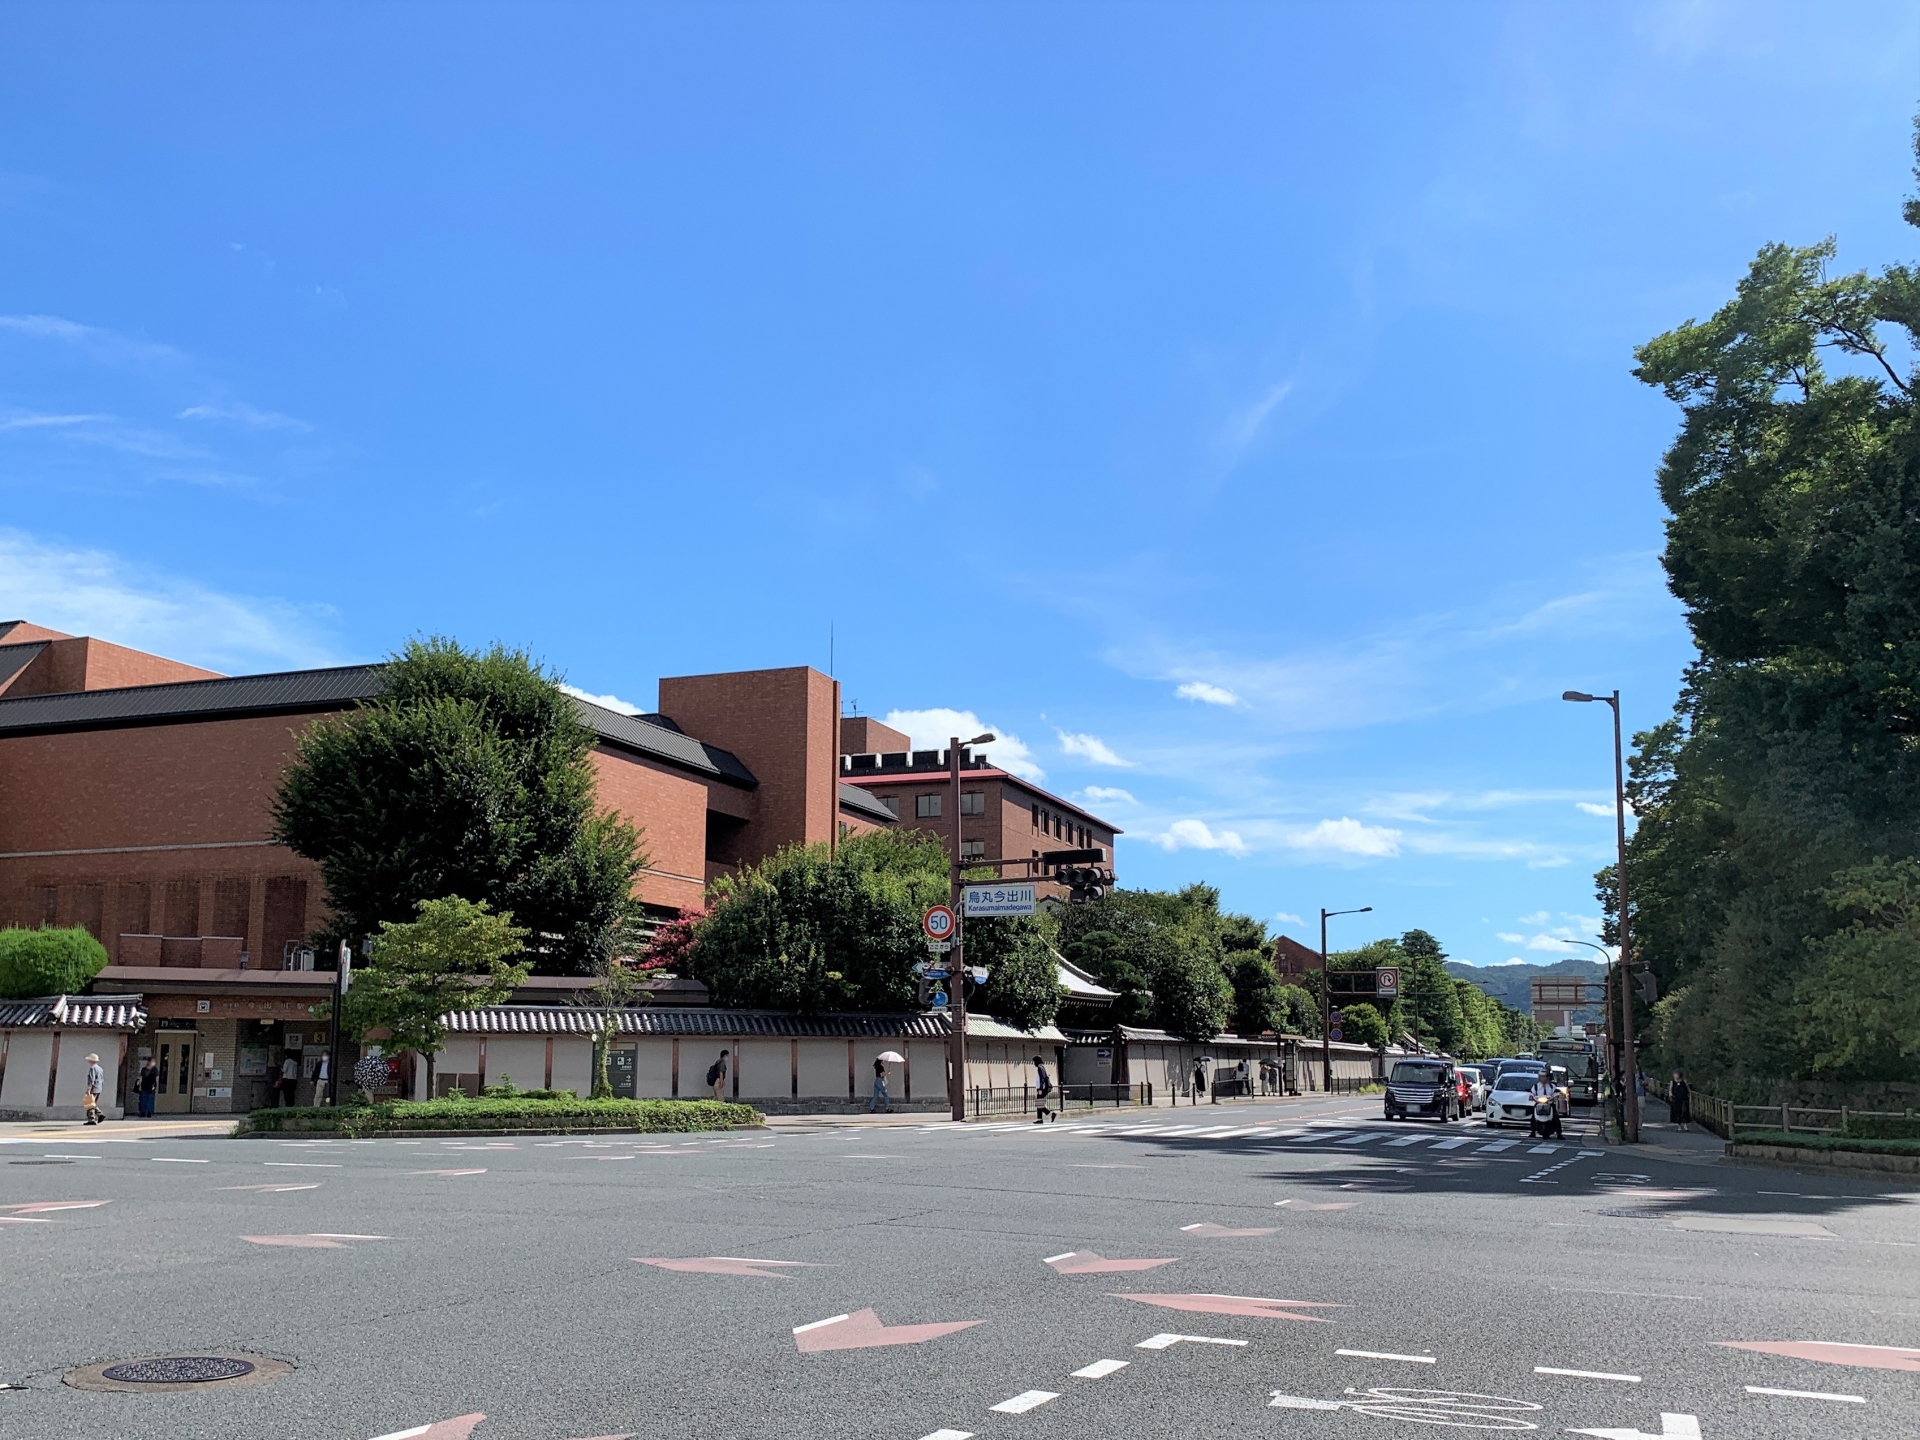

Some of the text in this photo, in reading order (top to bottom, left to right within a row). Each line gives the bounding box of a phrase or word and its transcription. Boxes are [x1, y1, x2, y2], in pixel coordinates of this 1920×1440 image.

[968, 889, 1031, 903] 烏丸今出川
[968, 904, 1032, 912] Karasumaimadegawa
[930, 915, 948, 930] 50
